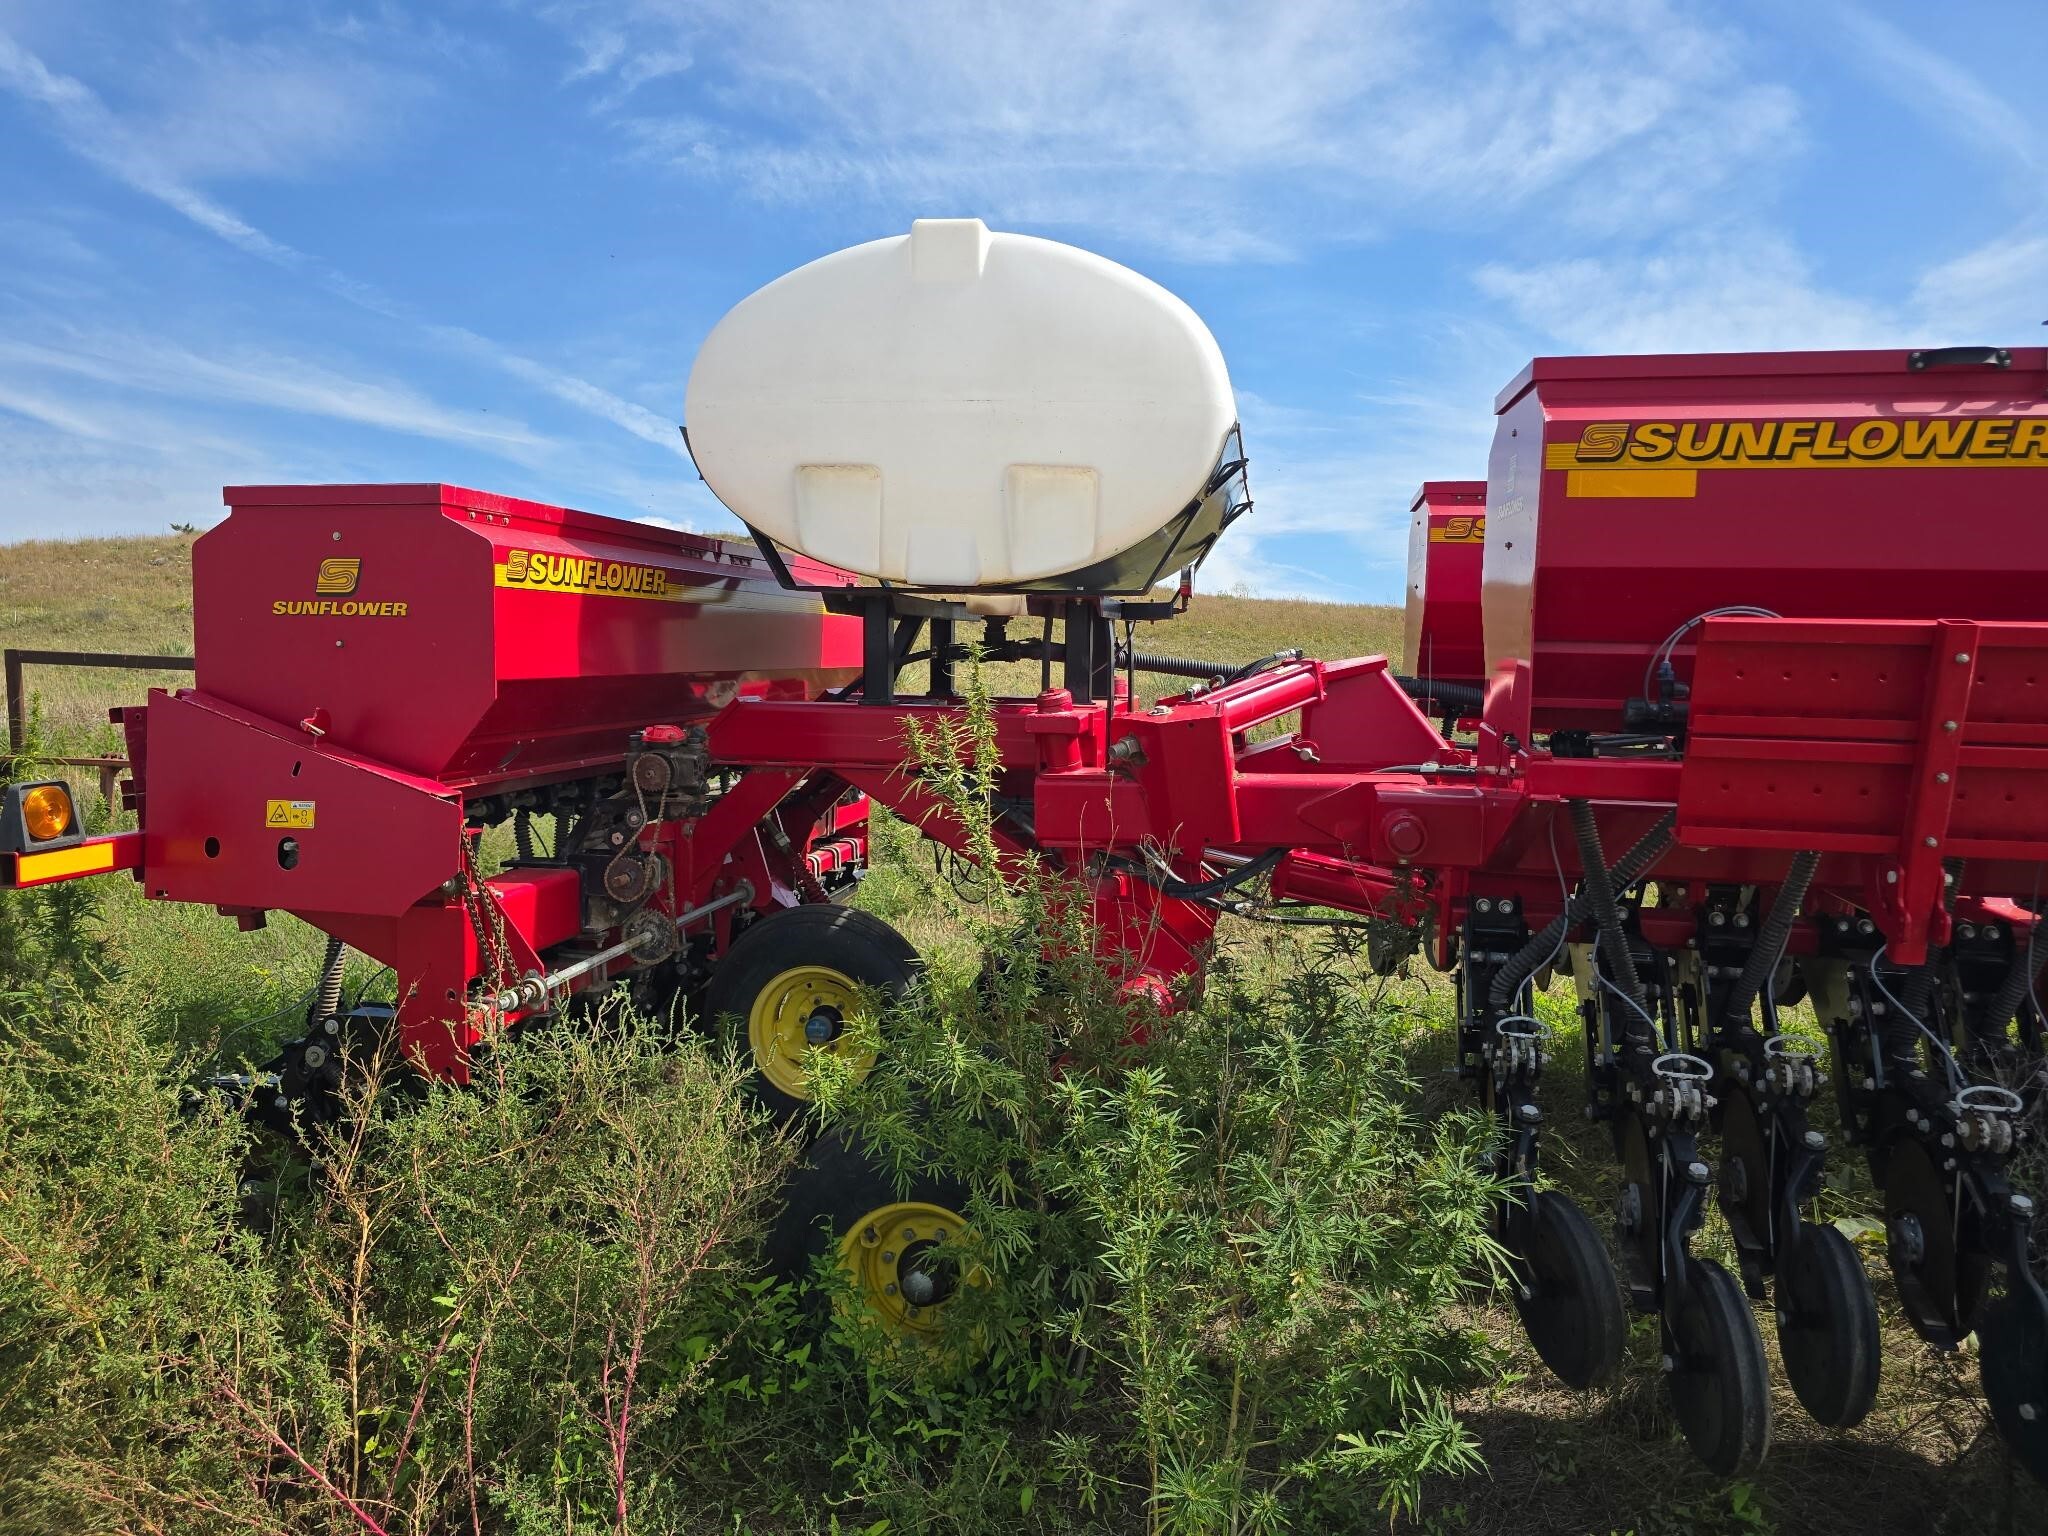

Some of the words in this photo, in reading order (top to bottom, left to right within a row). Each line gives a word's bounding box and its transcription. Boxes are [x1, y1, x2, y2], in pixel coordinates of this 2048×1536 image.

[1629, 419, 2047, 462] SUNFLOWER
[529, 553, 667, 594] SUNFLOWER
[272, 600, 408, 617] SUNFLOWER
